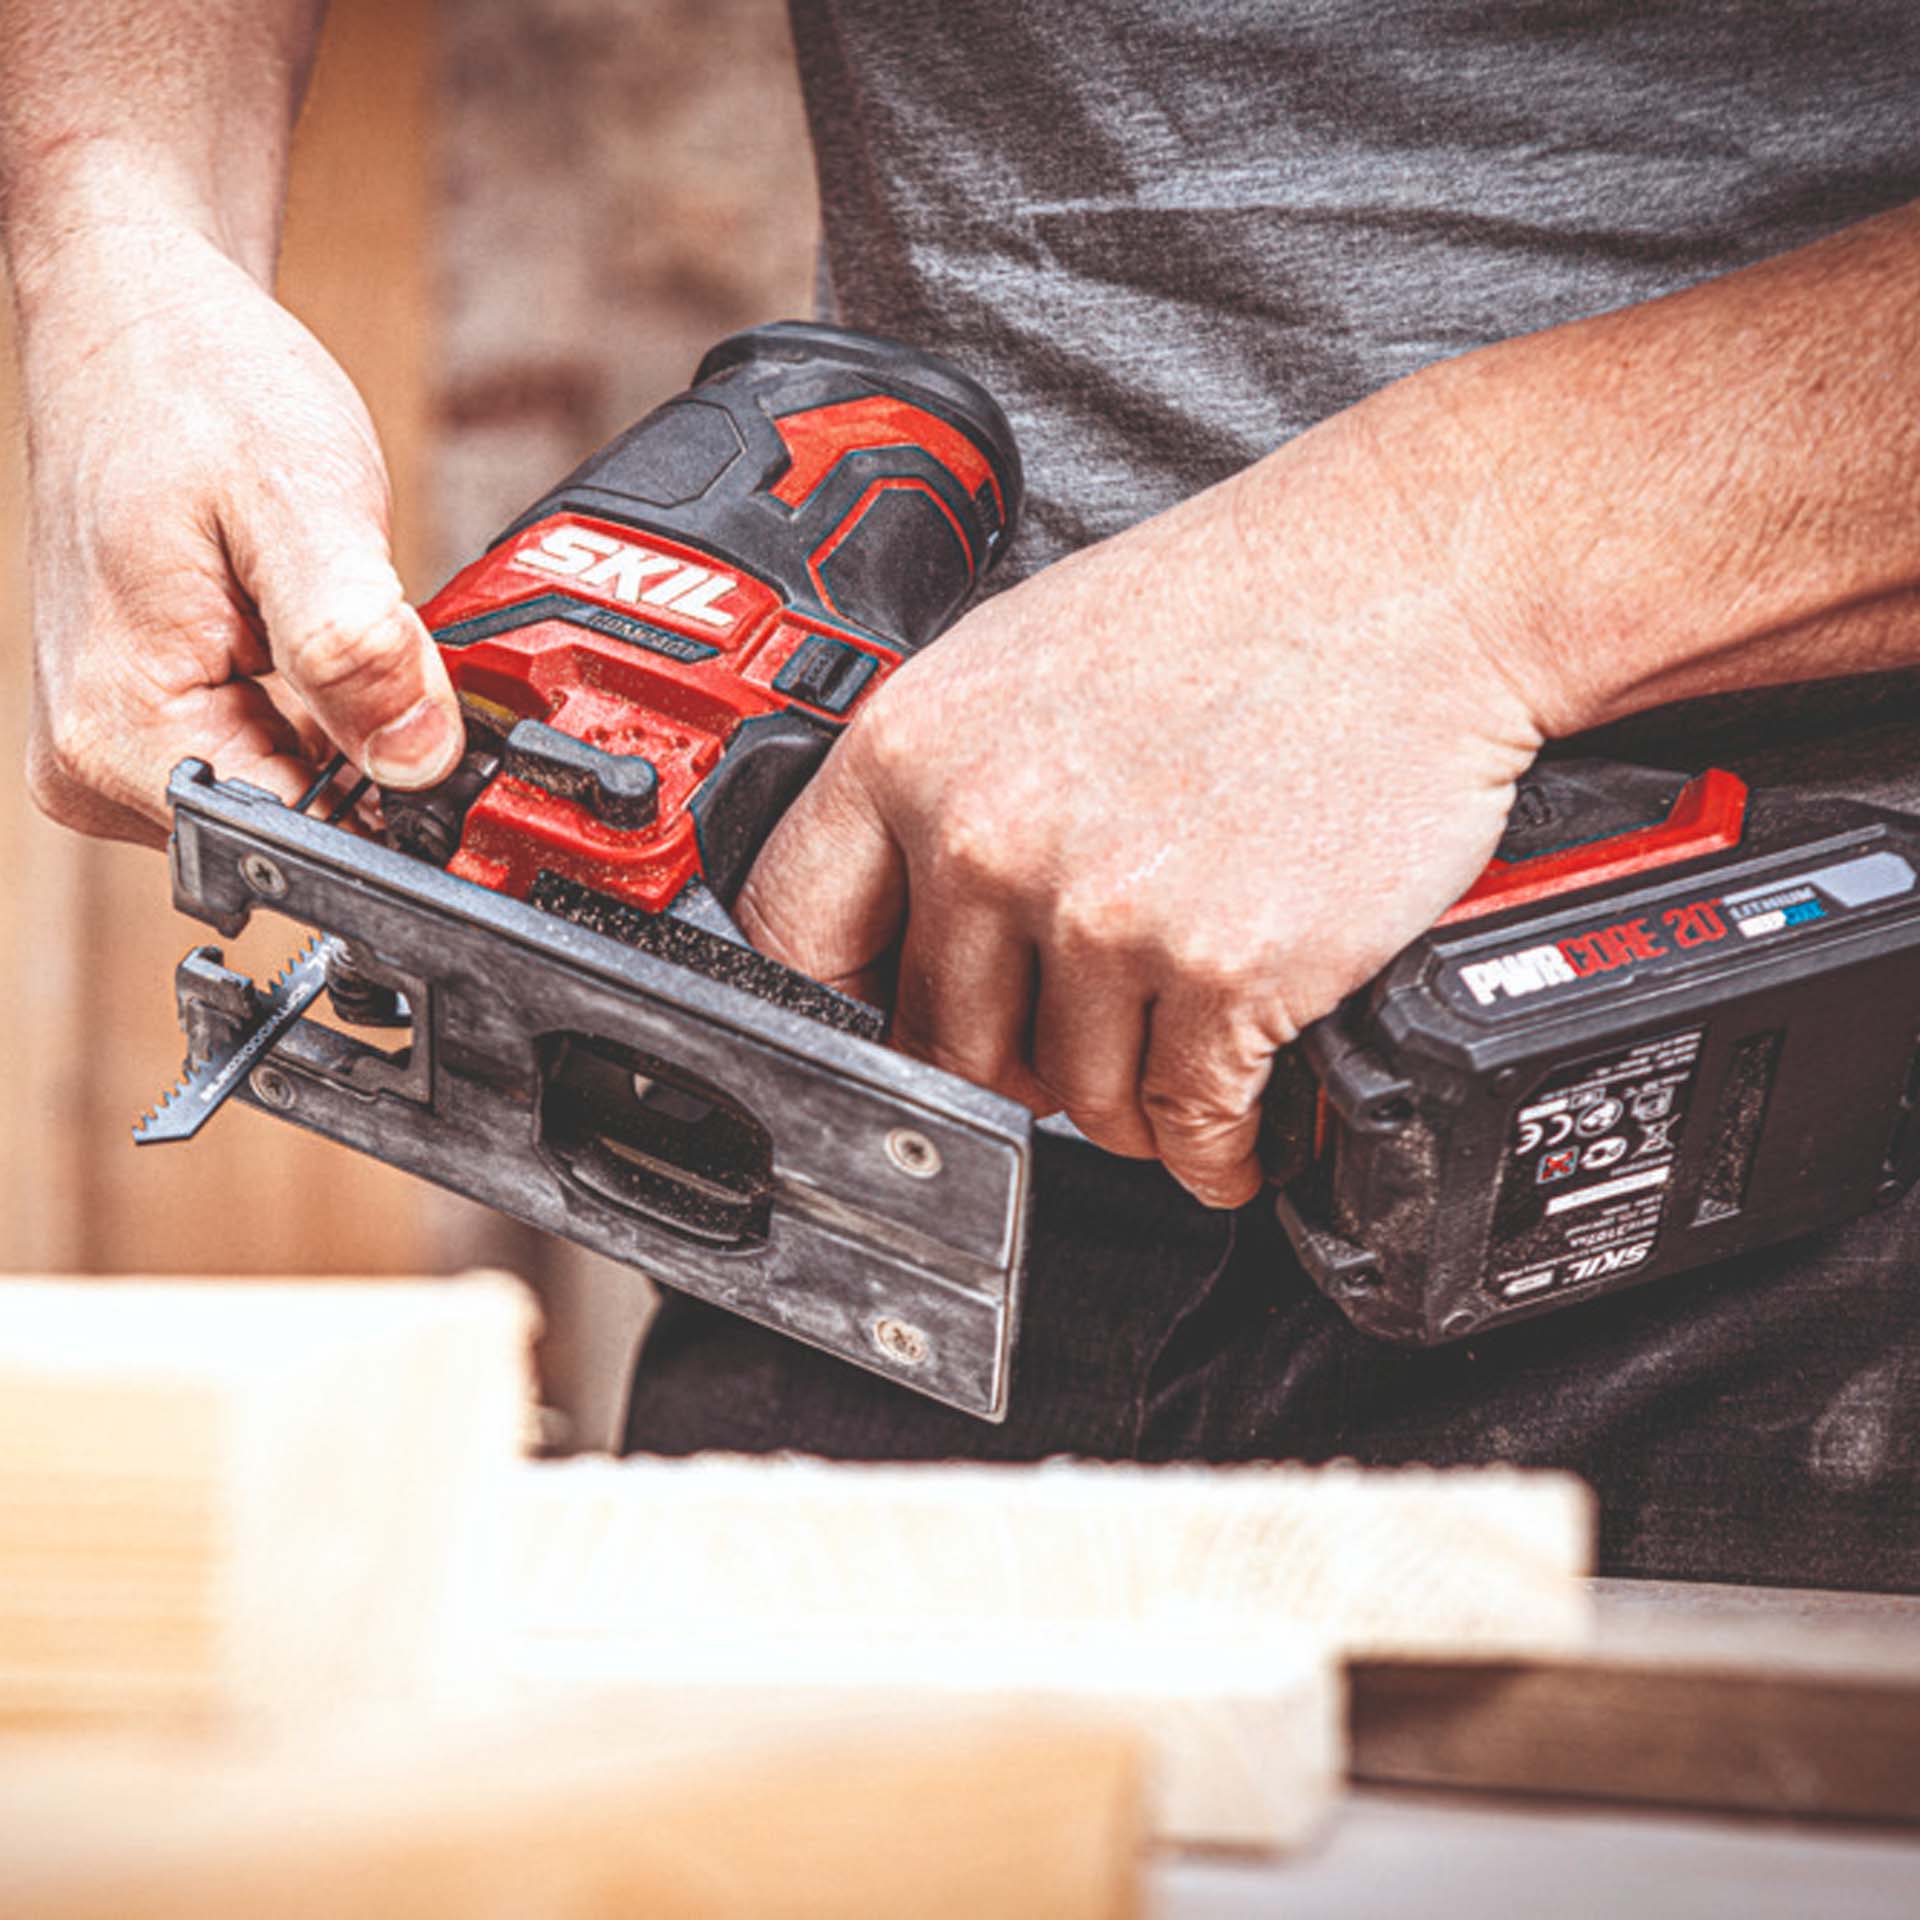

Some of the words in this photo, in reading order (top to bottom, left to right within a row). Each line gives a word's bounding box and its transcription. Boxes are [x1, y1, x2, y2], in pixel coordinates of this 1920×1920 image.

[514, 524, 738, 627] SKIL
[1457, 917, 1669, 1006] PWRCORE
[1565, 1240, 1655, 1283] SKIL
